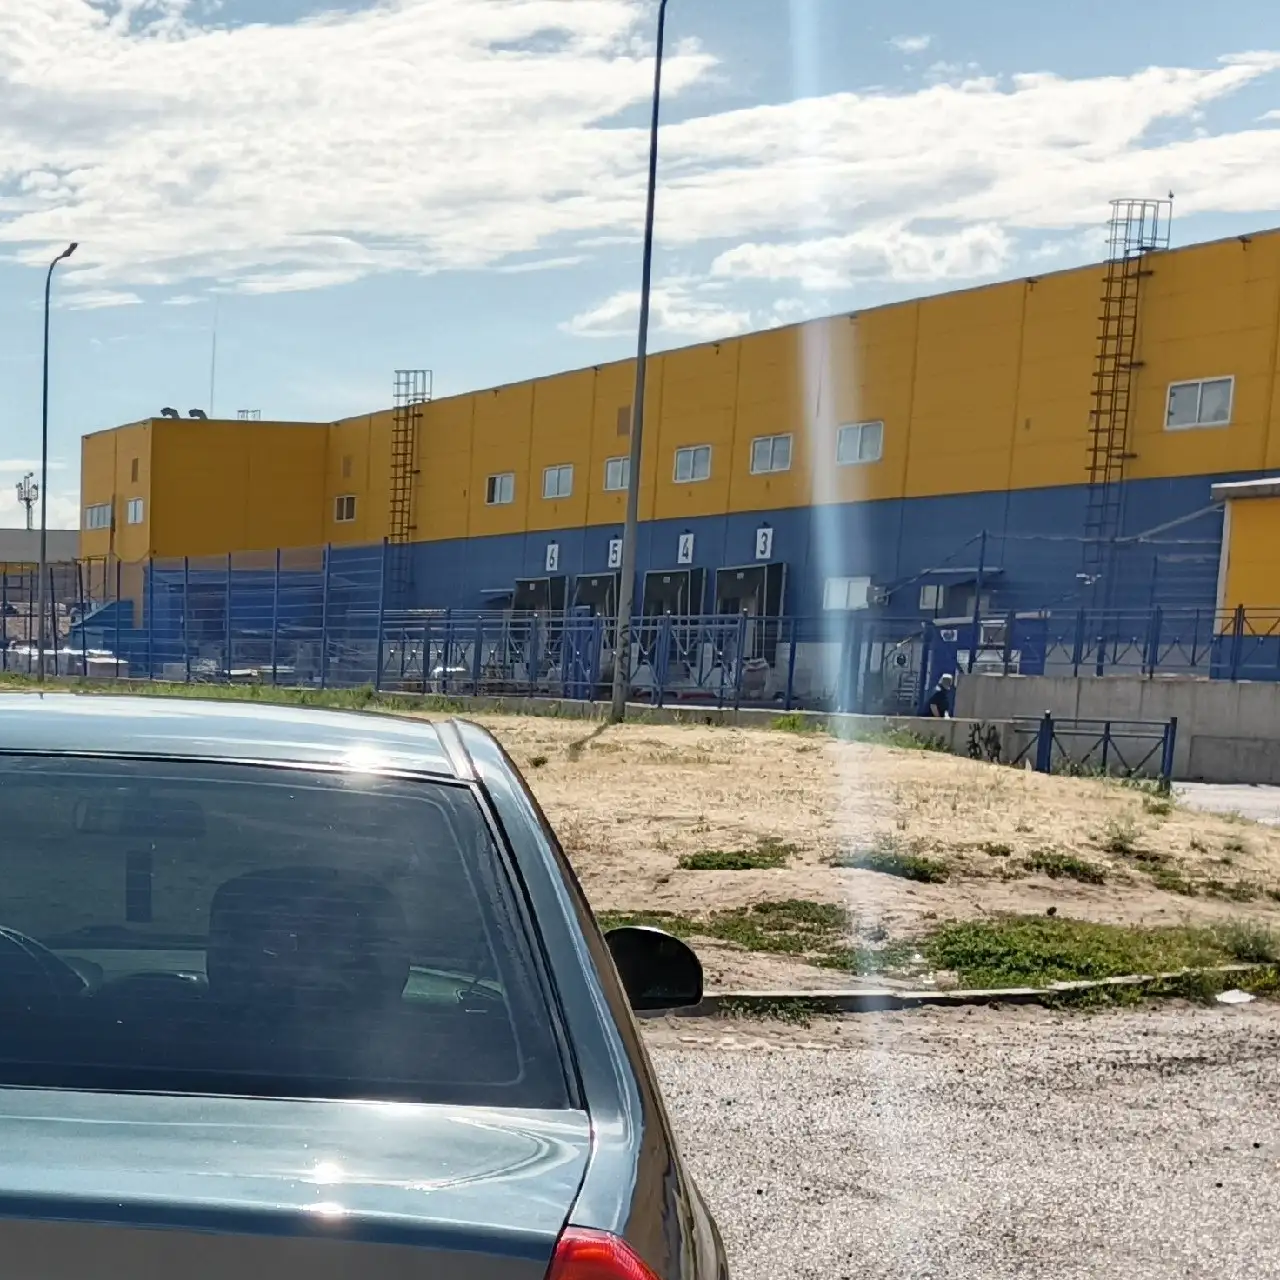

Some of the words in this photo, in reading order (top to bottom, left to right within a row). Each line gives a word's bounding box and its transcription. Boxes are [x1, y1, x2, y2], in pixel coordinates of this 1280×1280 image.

[610, 542, 618, 564] 5
[681, 537, 690, 559] 4
[759, 531, 769, 555] 3
[549, 547, 556, 568] 6
